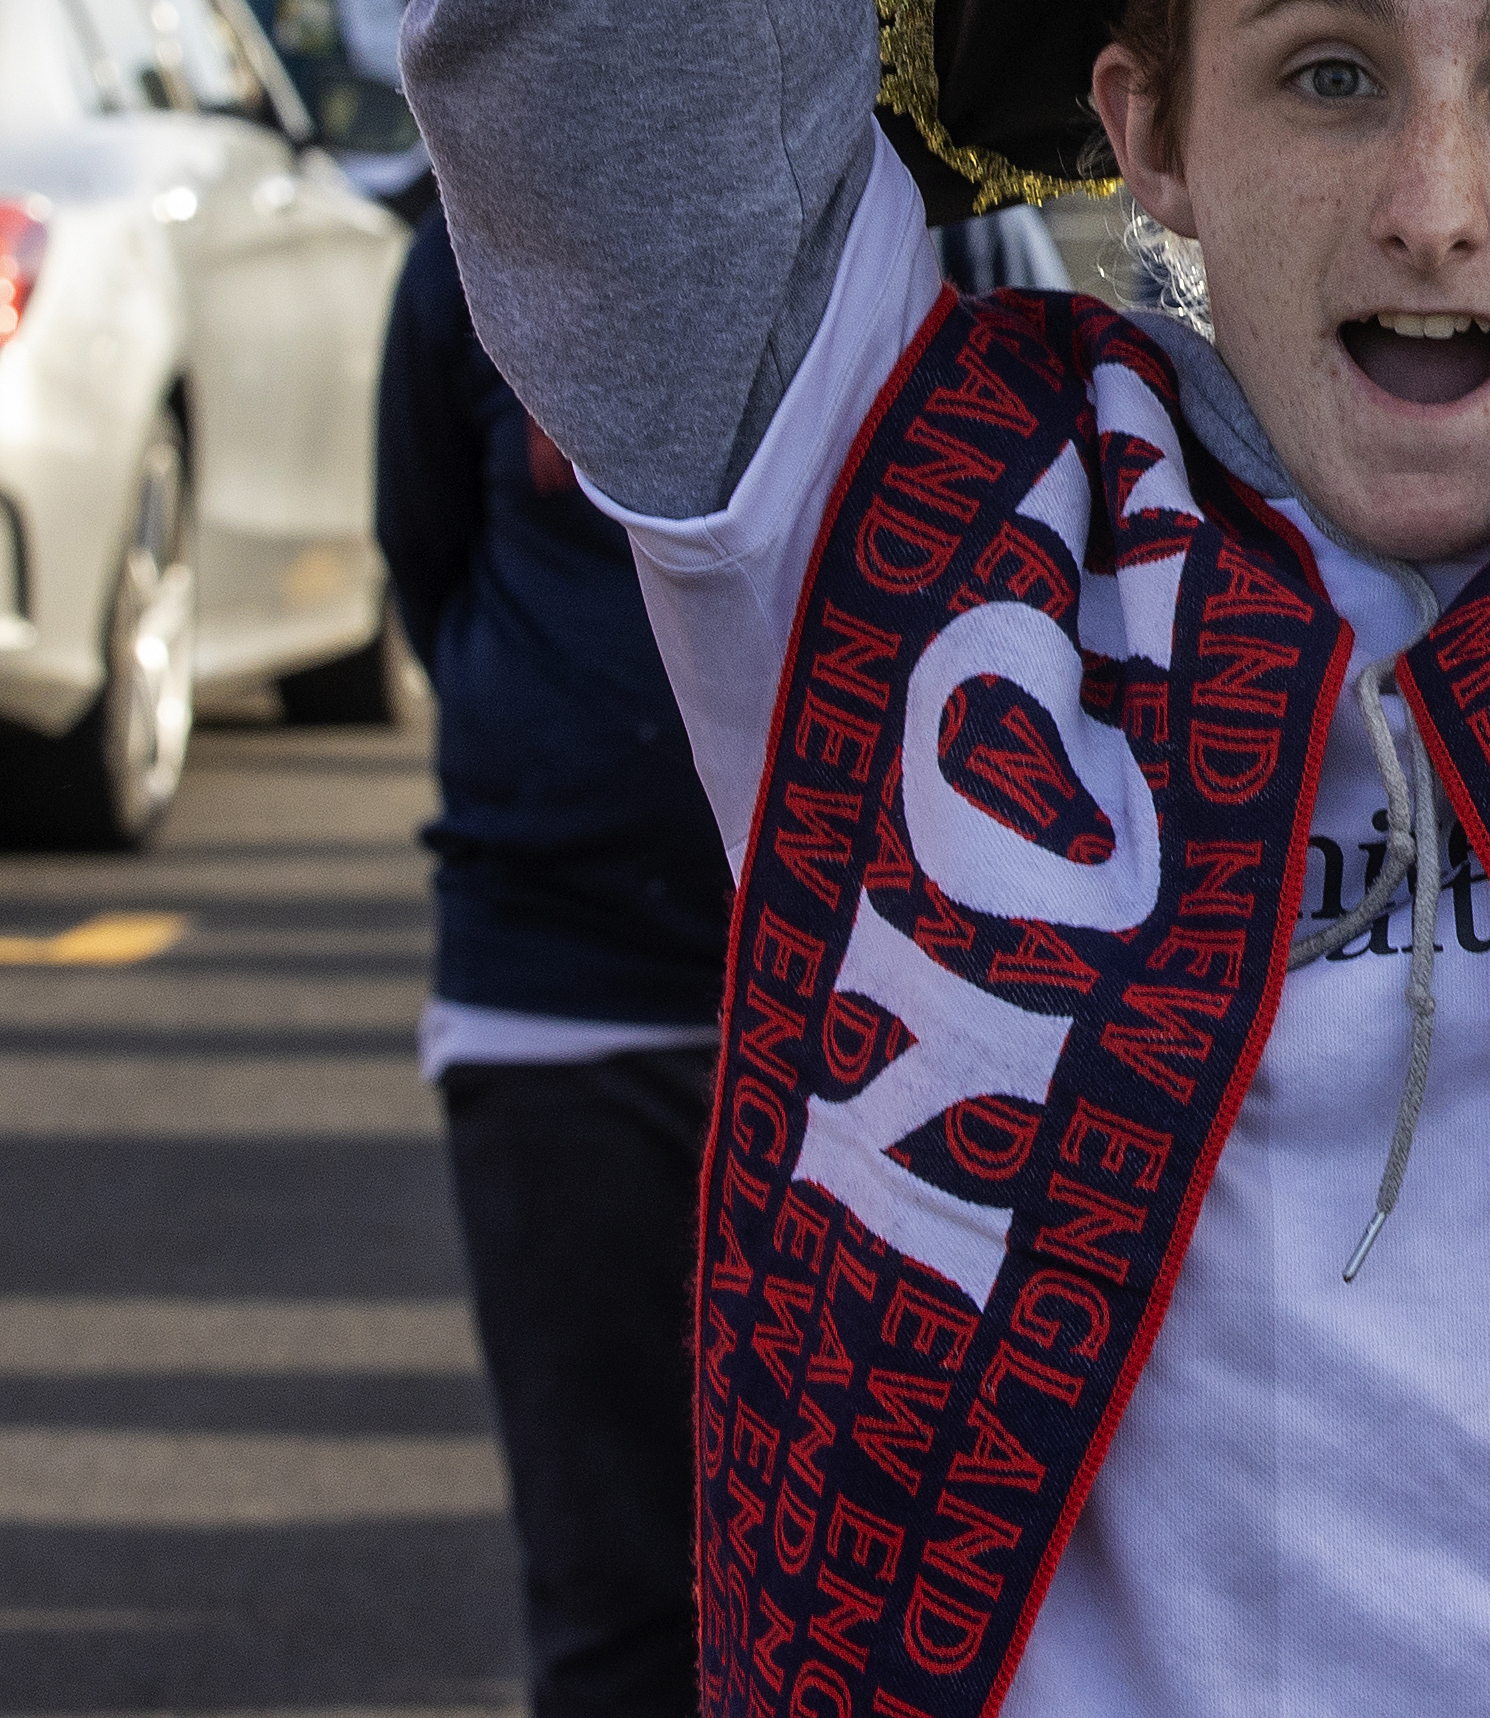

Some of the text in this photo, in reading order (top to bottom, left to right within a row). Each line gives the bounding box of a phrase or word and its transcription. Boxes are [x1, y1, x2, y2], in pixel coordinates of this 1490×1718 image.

[772, 599, 901, 912] NEW
[1188, 537, 1314, 806] AND
[1100, 838, 1264, 1105] NEW
[699, 905, 827, 1480] ENGLAND
[750, 1186, 831, 1400] EW
[850, 1278, 979, 1497] EW
[901, 1098, 1173, 1675] ENGLAND
